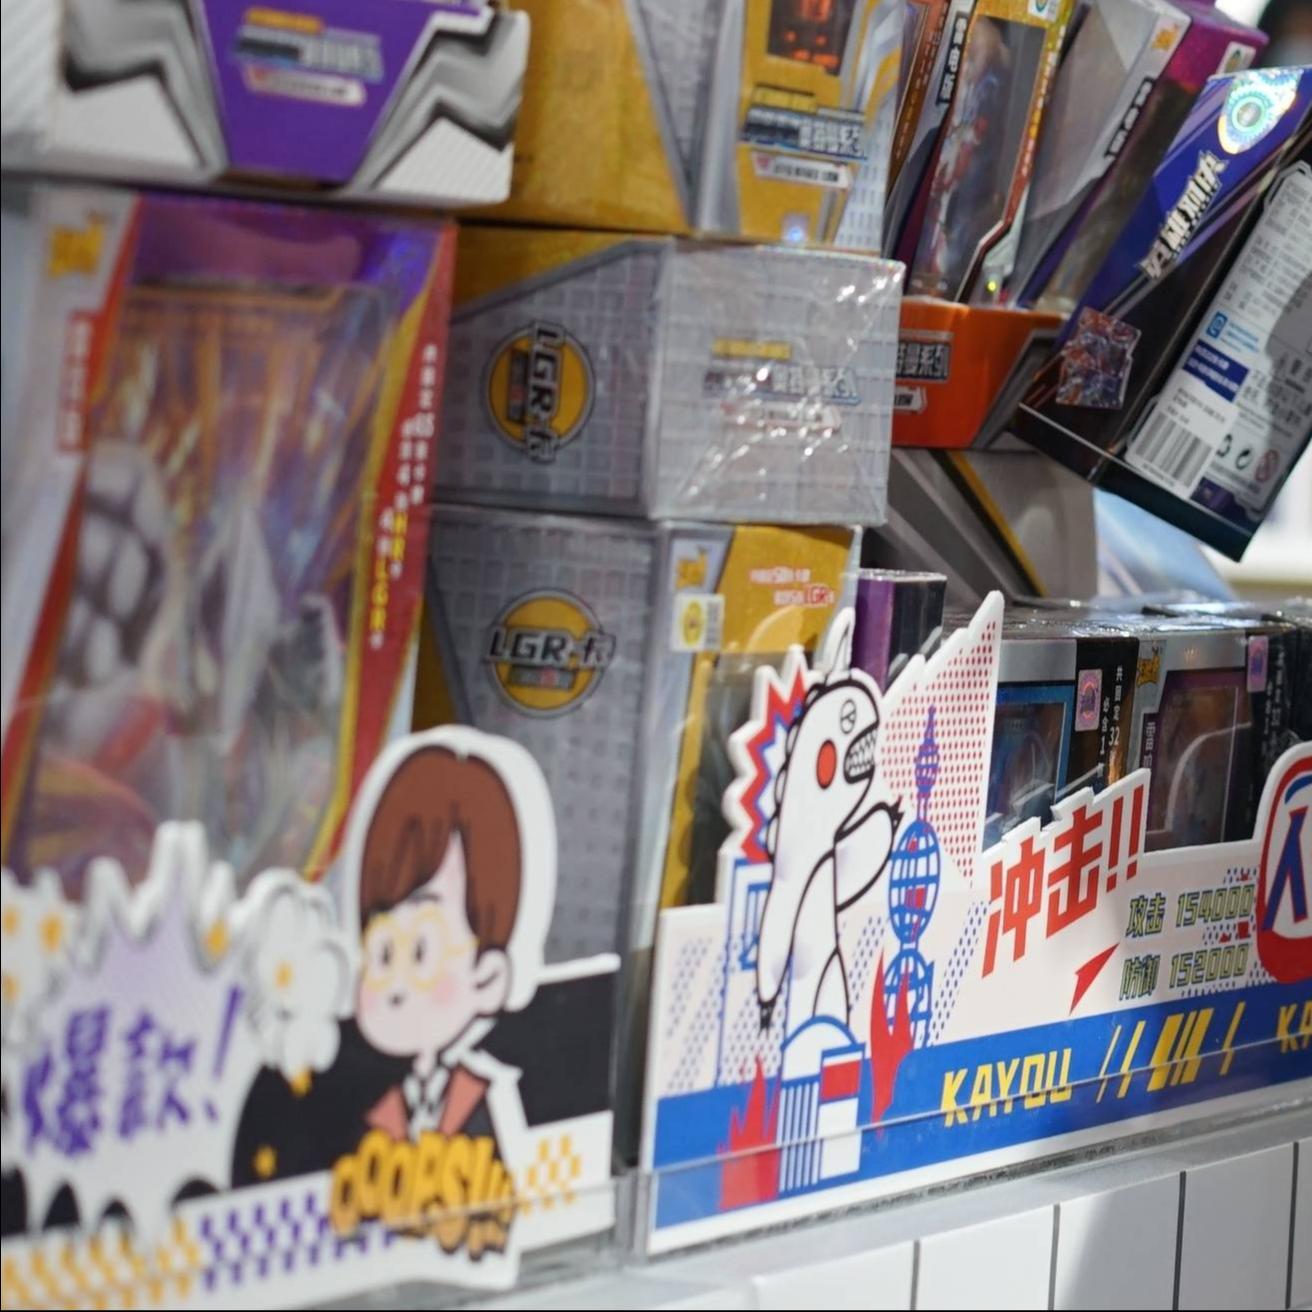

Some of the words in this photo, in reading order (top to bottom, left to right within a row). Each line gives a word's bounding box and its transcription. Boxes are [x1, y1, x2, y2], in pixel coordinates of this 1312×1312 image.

[982, 784, 1144, 979] 冲击!!
[1125, 892, 1166, 938] 攻击
[1175, 884, 1256, 928] 154000
[1169, 943, 1253, 989] 152000
[940, 1048, 1073, 1128] KAYOU
